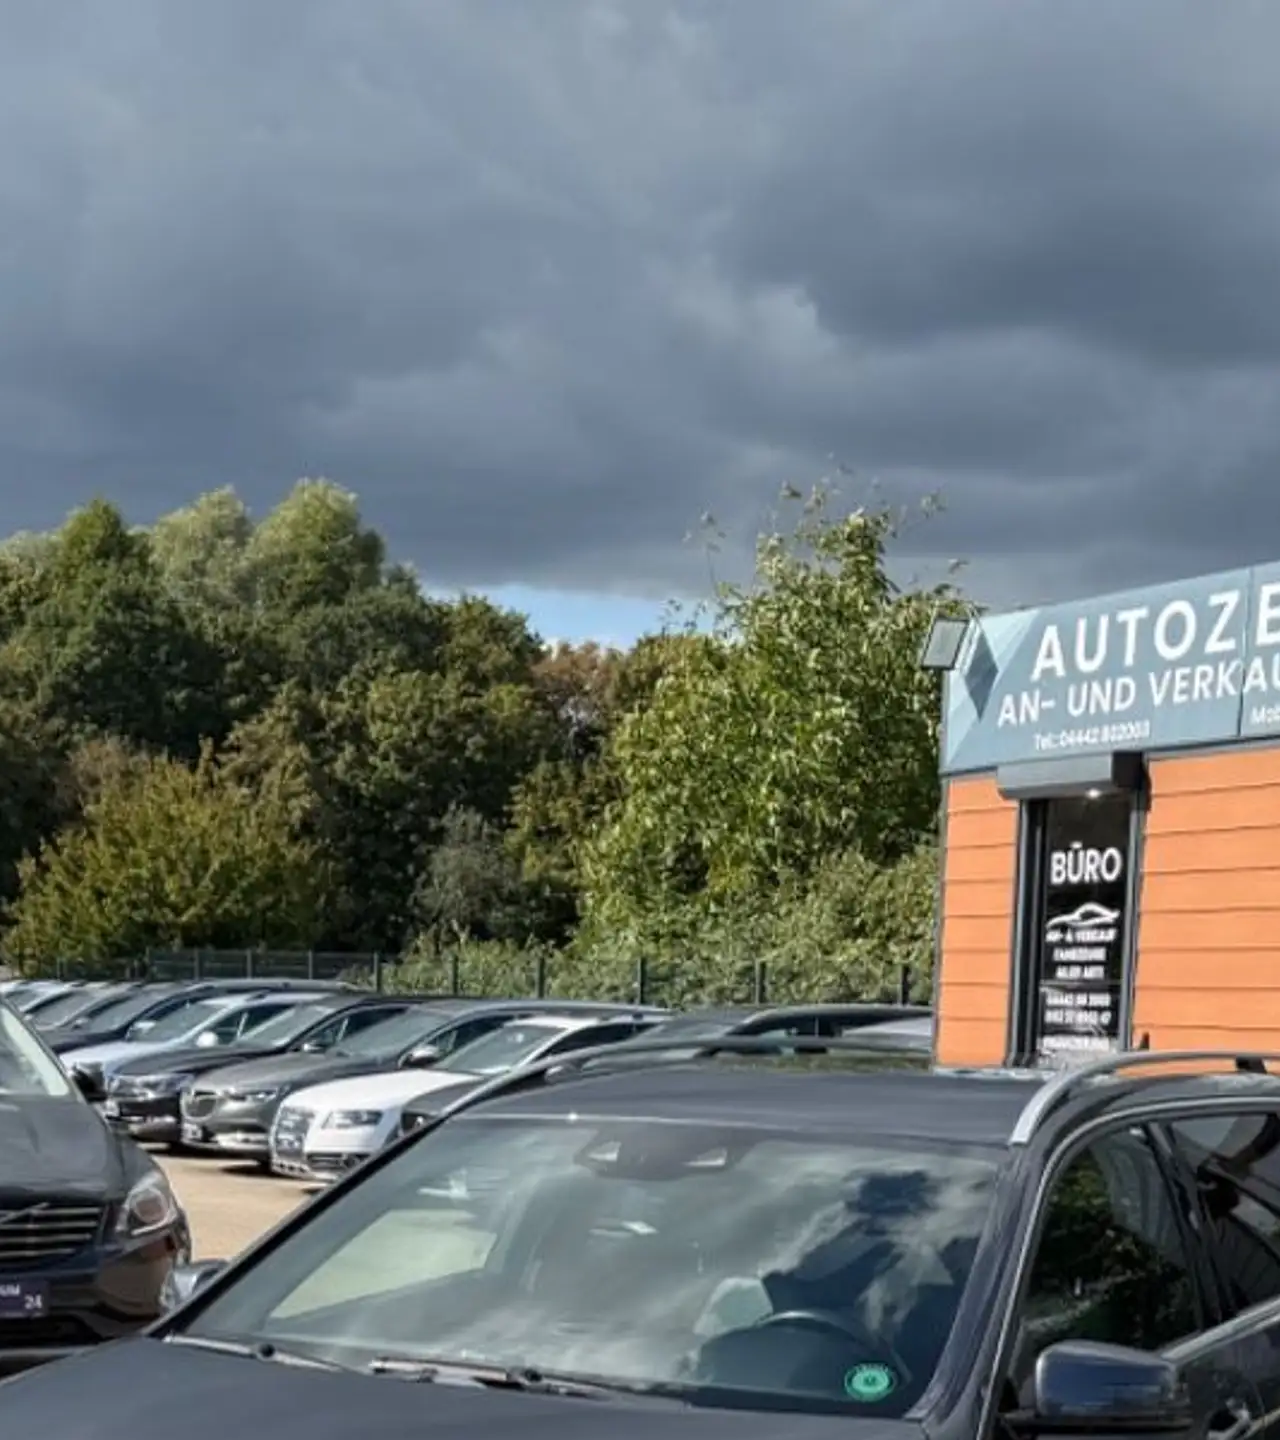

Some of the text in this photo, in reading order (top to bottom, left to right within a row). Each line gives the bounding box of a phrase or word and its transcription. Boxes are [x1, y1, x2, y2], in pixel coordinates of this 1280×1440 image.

[998, 689, 1056, 728] AN-
[1068, 673, 1138, 718] UND
[1051, 841, 1123, 884] BÜRO
